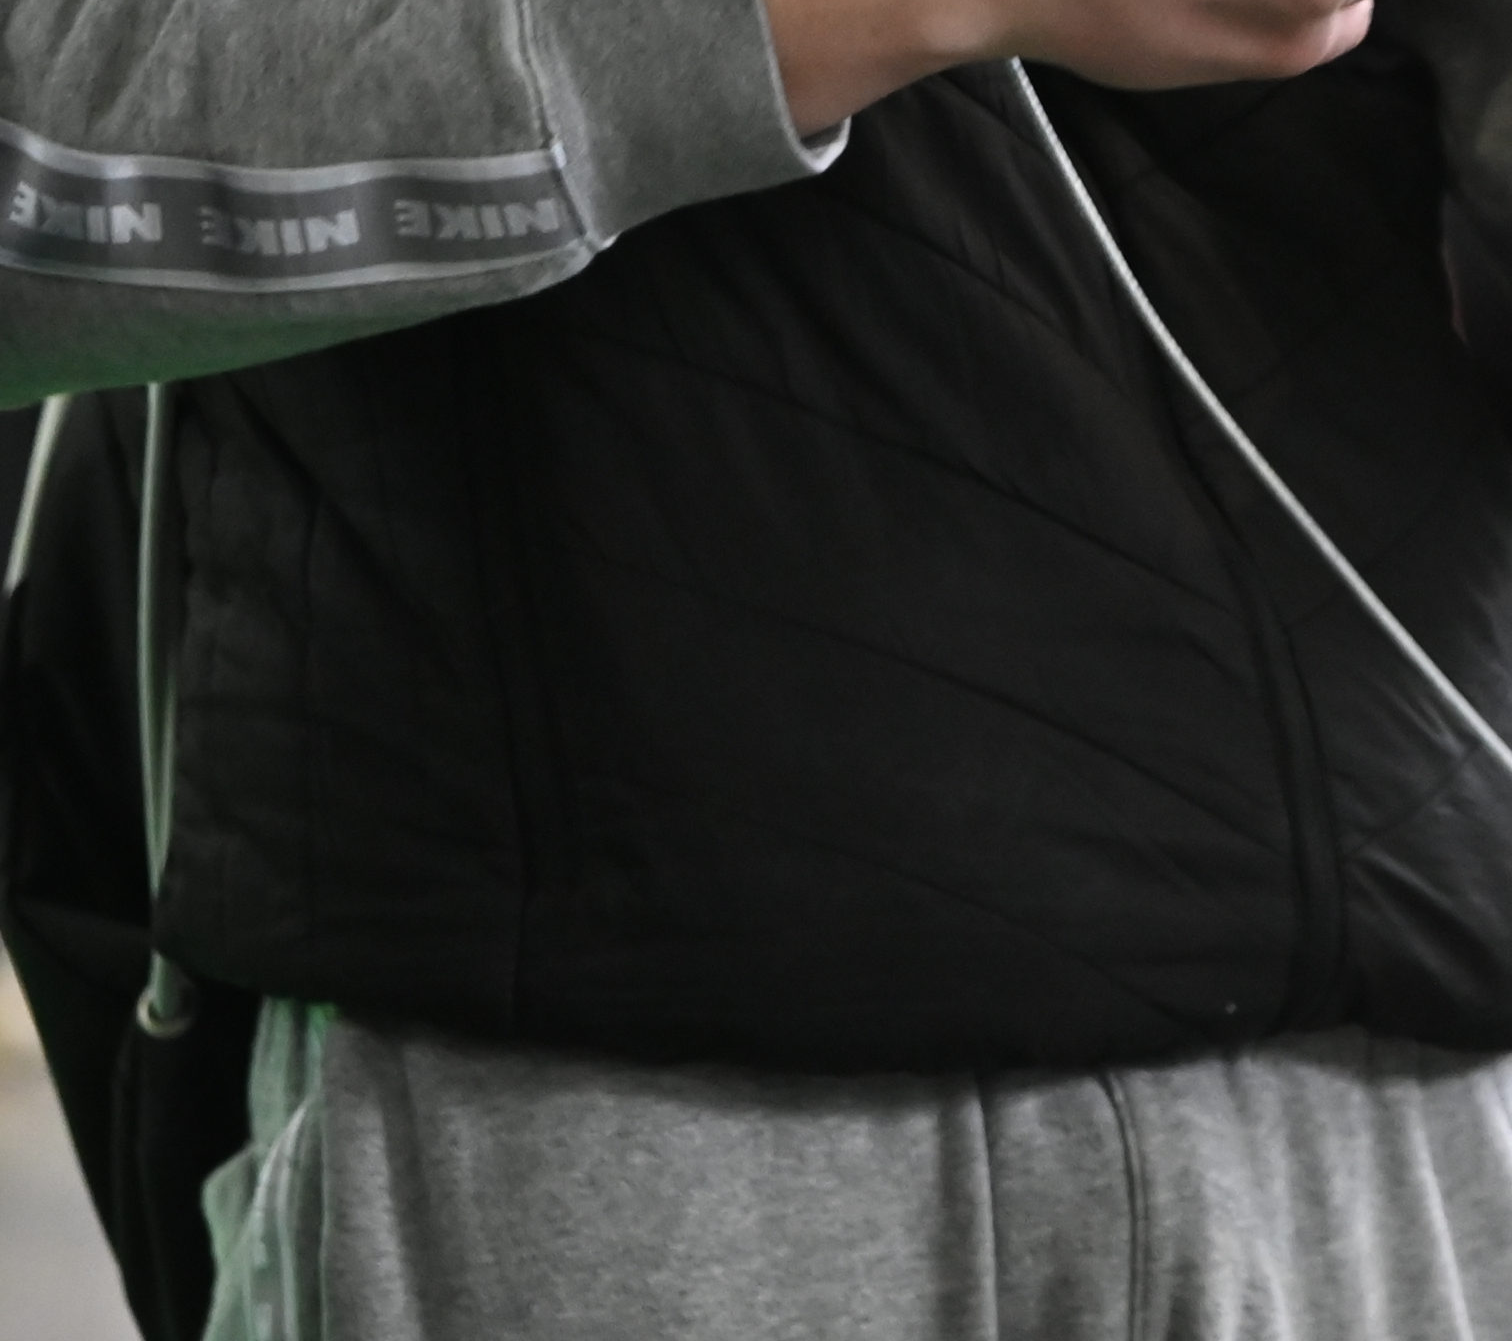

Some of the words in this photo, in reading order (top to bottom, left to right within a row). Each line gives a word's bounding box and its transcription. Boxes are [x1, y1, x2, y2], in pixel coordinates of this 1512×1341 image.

[5, 180, 164, 245] NIKE
[199, 203, 361, 257] NIKE
[392, 197, 561, 241] NIKE
